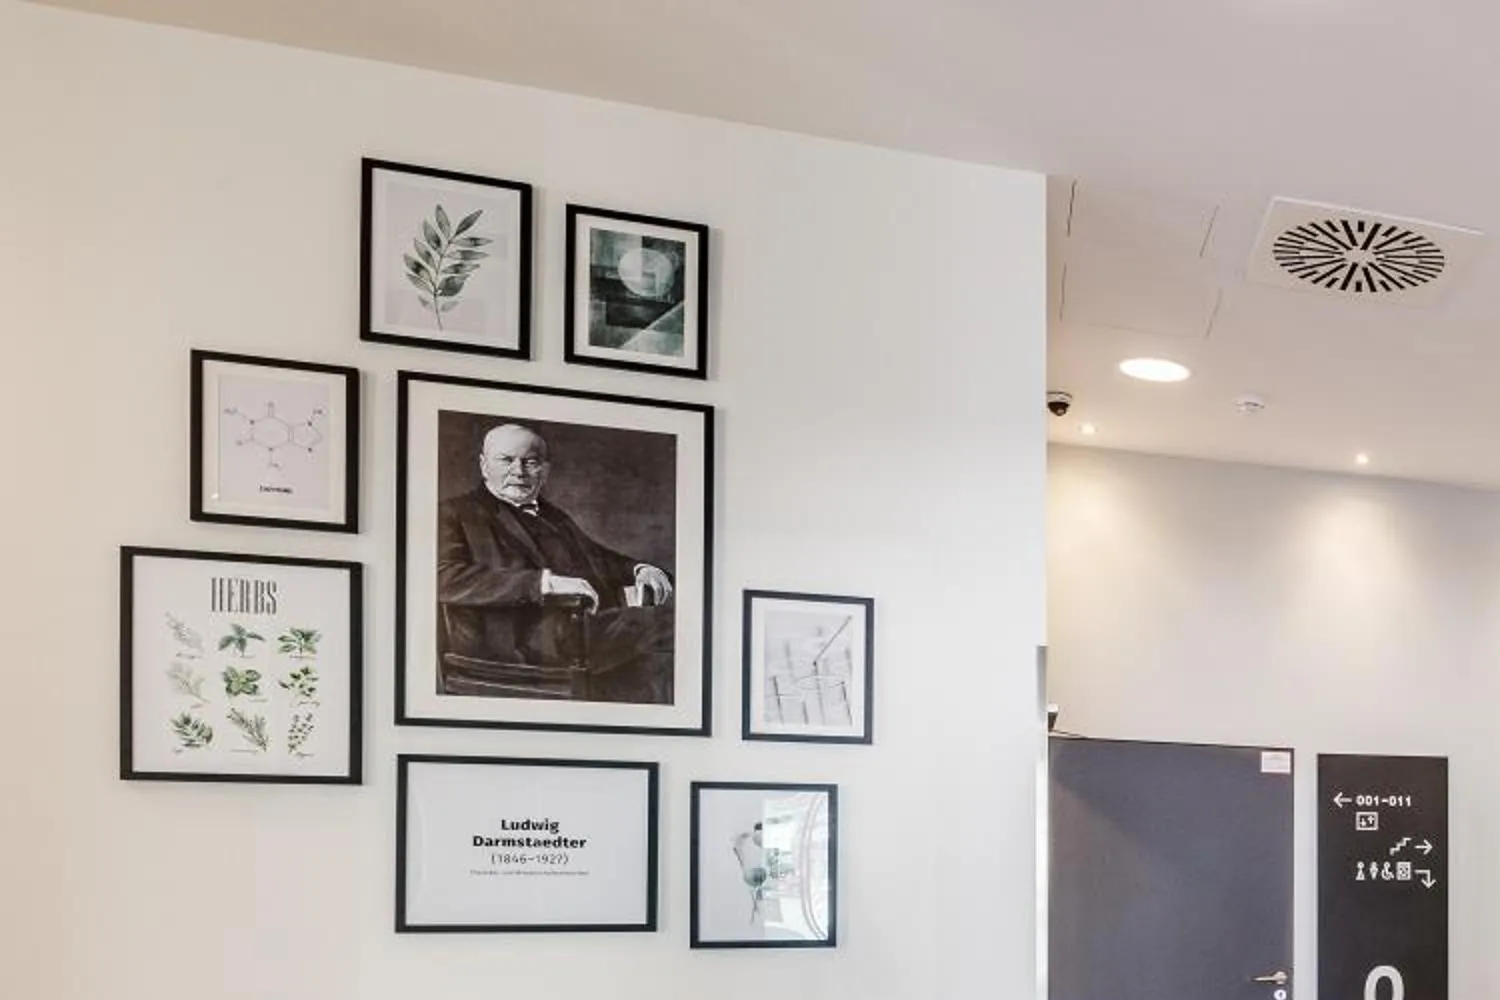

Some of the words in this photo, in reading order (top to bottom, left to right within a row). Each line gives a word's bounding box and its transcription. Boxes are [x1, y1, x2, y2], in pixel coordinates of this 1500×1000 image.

[211, 577, 277, 615] HERBS
[500, 818, 561, 835] Ludwig
[472, 835, 588, 848] Darmstaedter
